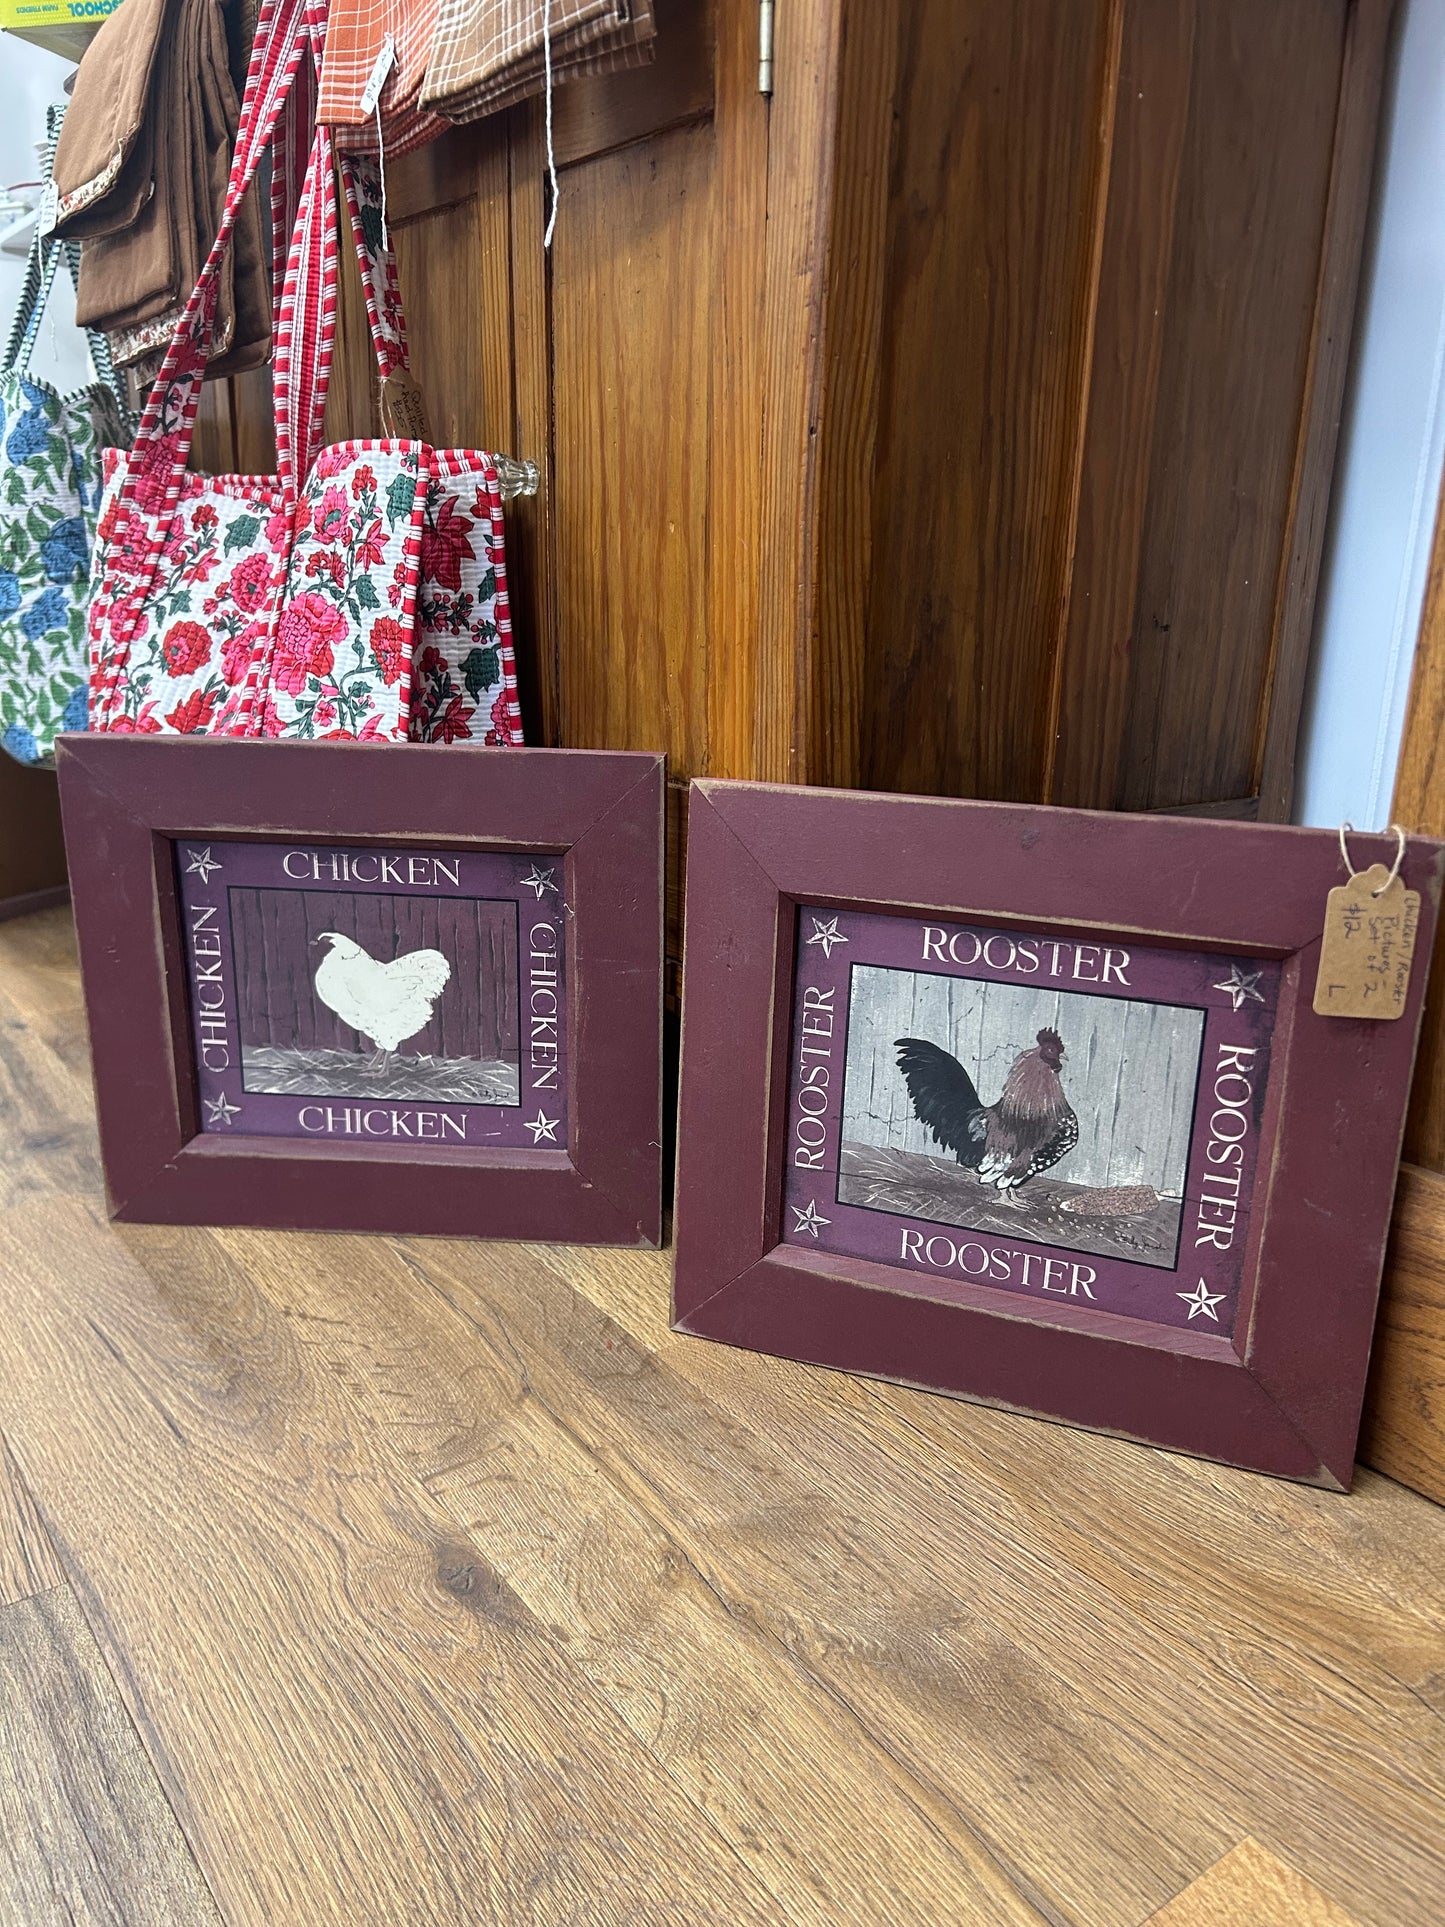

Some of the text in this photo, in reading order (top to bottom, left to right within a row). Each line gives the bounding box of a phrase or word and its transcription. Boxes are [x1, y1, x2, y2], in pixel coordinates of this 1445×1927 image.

[282, 850, 461, 887] CHICKEN
[920, 926, 1132, 986] ROOSTER
[1342, 902, 1368, 940] $12
[1362, 916, 1382, 999] Set of 2
[190, 904, 230, 1073] CHICKEN
[528, 921, 559, 1091] CHICKEN
[1328, 984, 1346, 998] L
[794, 986, 836, 1172] ROOSTER
[298, 1105, 468, 1140] CHICKEN
[1194, 1043, 1257, 1252] ROOSTER
[899, 1228, 1099, 1301] ROOSTER
